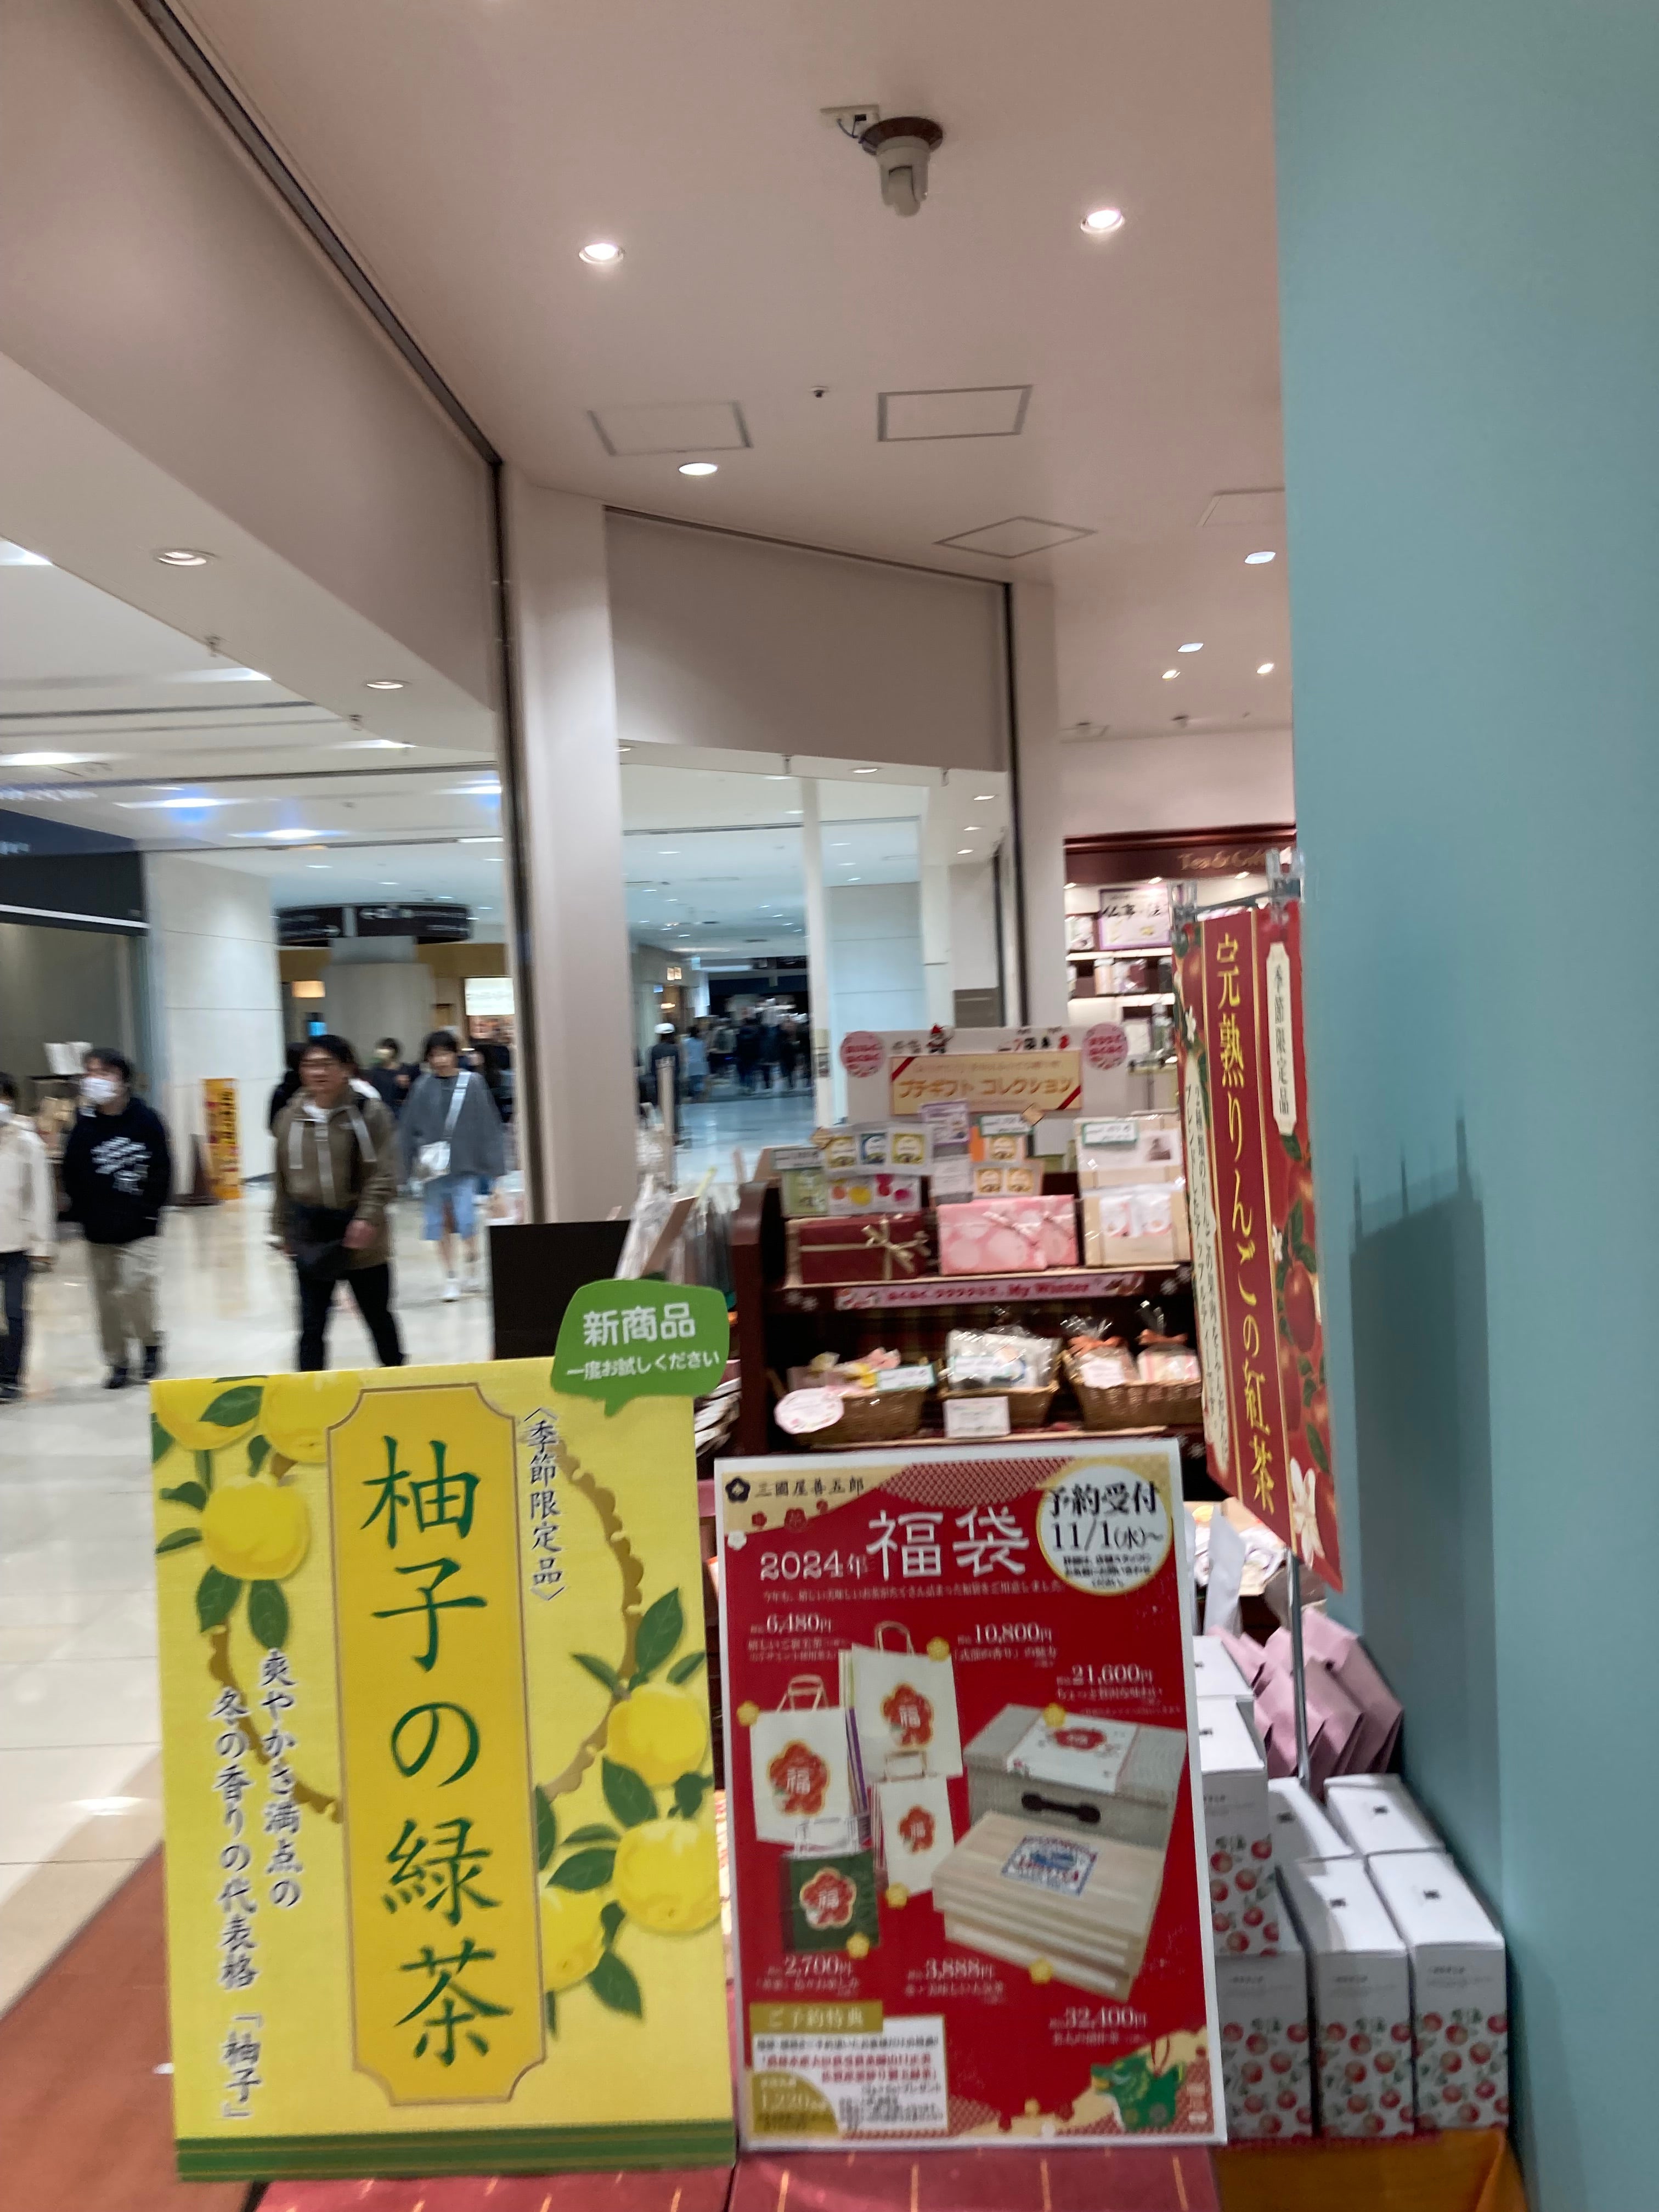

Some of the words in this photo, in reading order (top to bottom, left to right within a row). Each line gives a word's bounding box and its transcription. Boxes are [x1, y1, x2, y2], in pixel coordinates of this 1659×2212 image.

[899, 1079, 974, 1098] プチギフト
[980, 1077, 1074, 1095] コレクション
[1274, 964, 1289, 1116] 季節限定品
[1216, 931, 1274, 1515] 完熟りんごの紅茶
[566, 1350, 720, 1381] 一度お試しください
[583, 1302, 696, 1347] 新商品
[760, 1550, 868, 1581] 2024年
[865, 1506, 1030, 1582] 福袋
[1049, 1481, 1160, 1519] 予約受付
[260, 1648, 304, 1908] 爽やかさ満点の
[359, 1434, 514, 2067] 柚子の緑茶
[210, 1687, 260, 1989] 冬の香りの代表格
